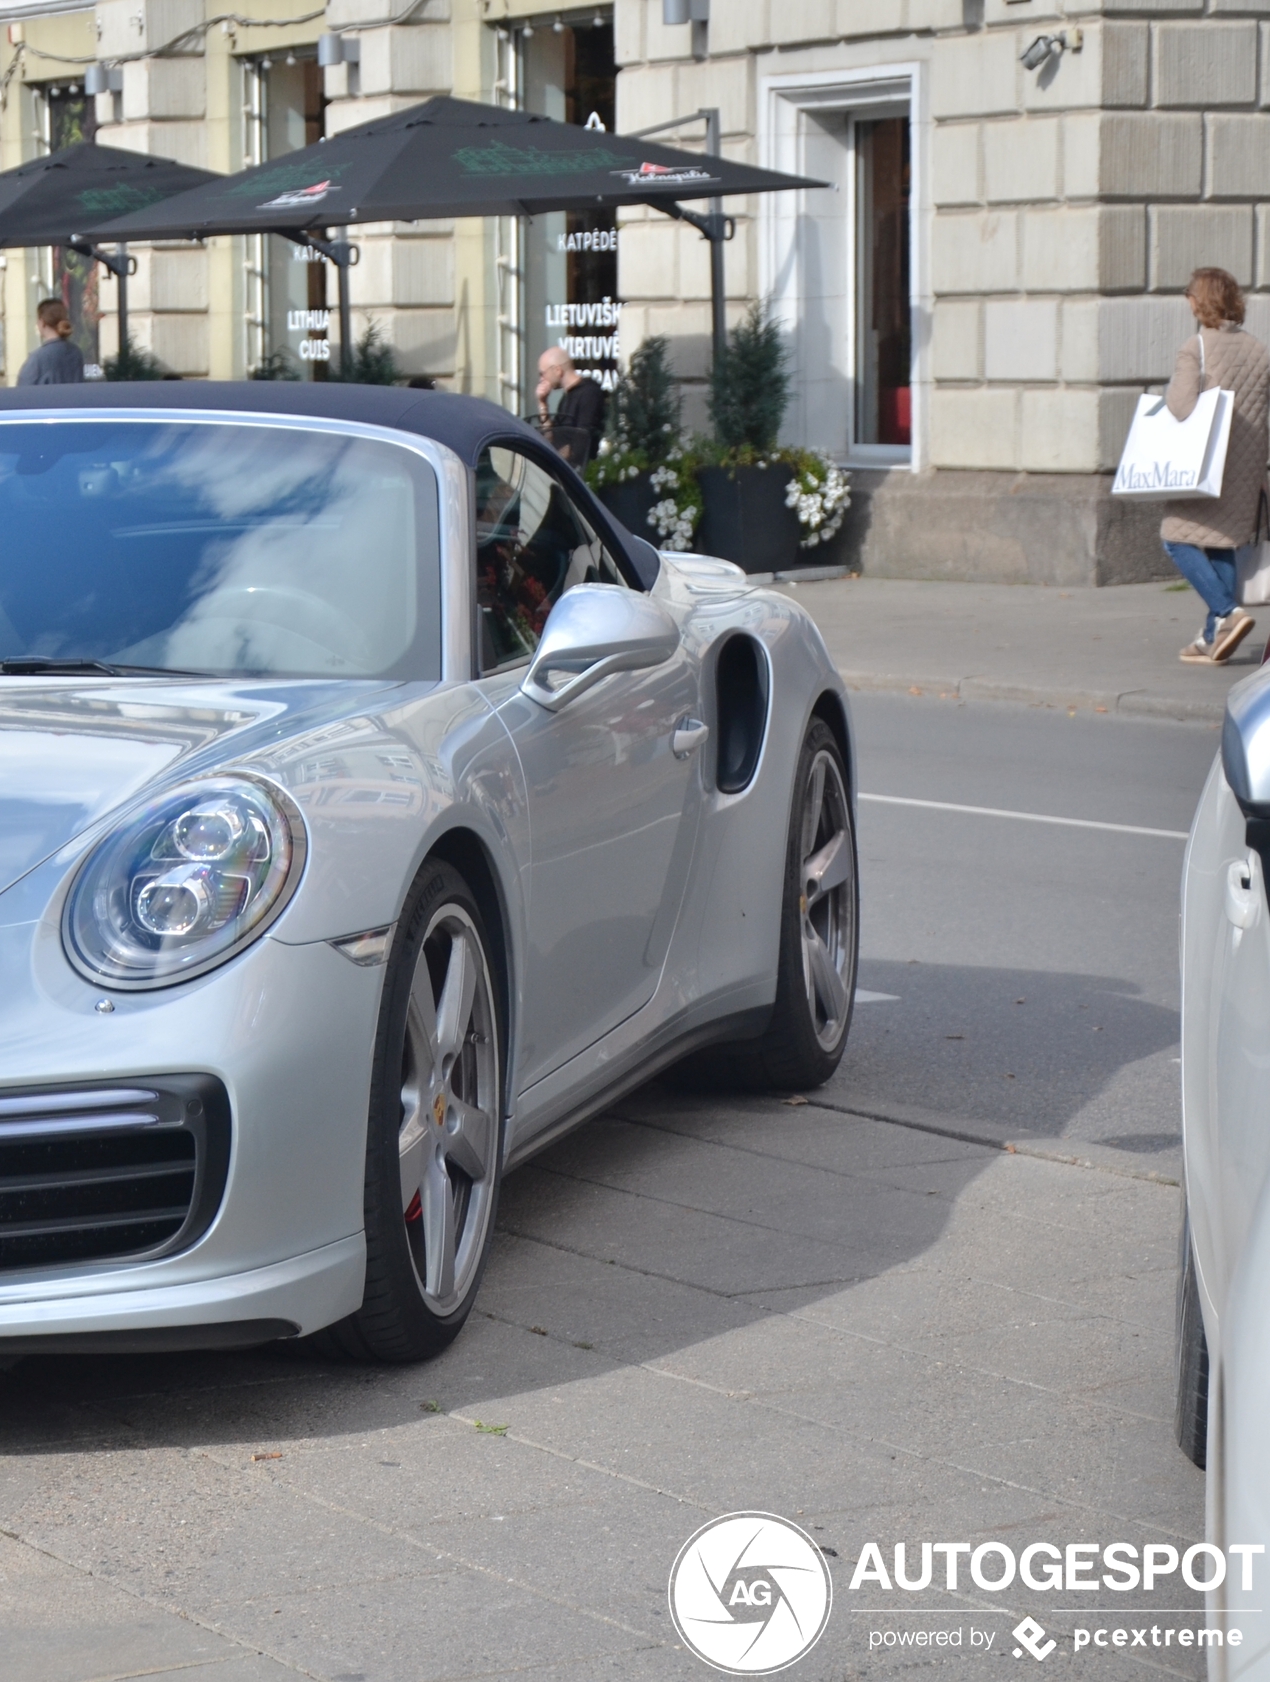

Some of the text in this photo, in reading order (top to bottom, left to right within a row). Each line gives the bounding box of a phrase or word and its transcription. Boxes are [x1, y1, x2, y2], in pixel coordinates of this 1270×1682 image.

[545, 296, 629, 328] LIETUVIŠK
[298, 338, 330, 361] CUIS
[1114, 461, 1196, 490] MaxMara
